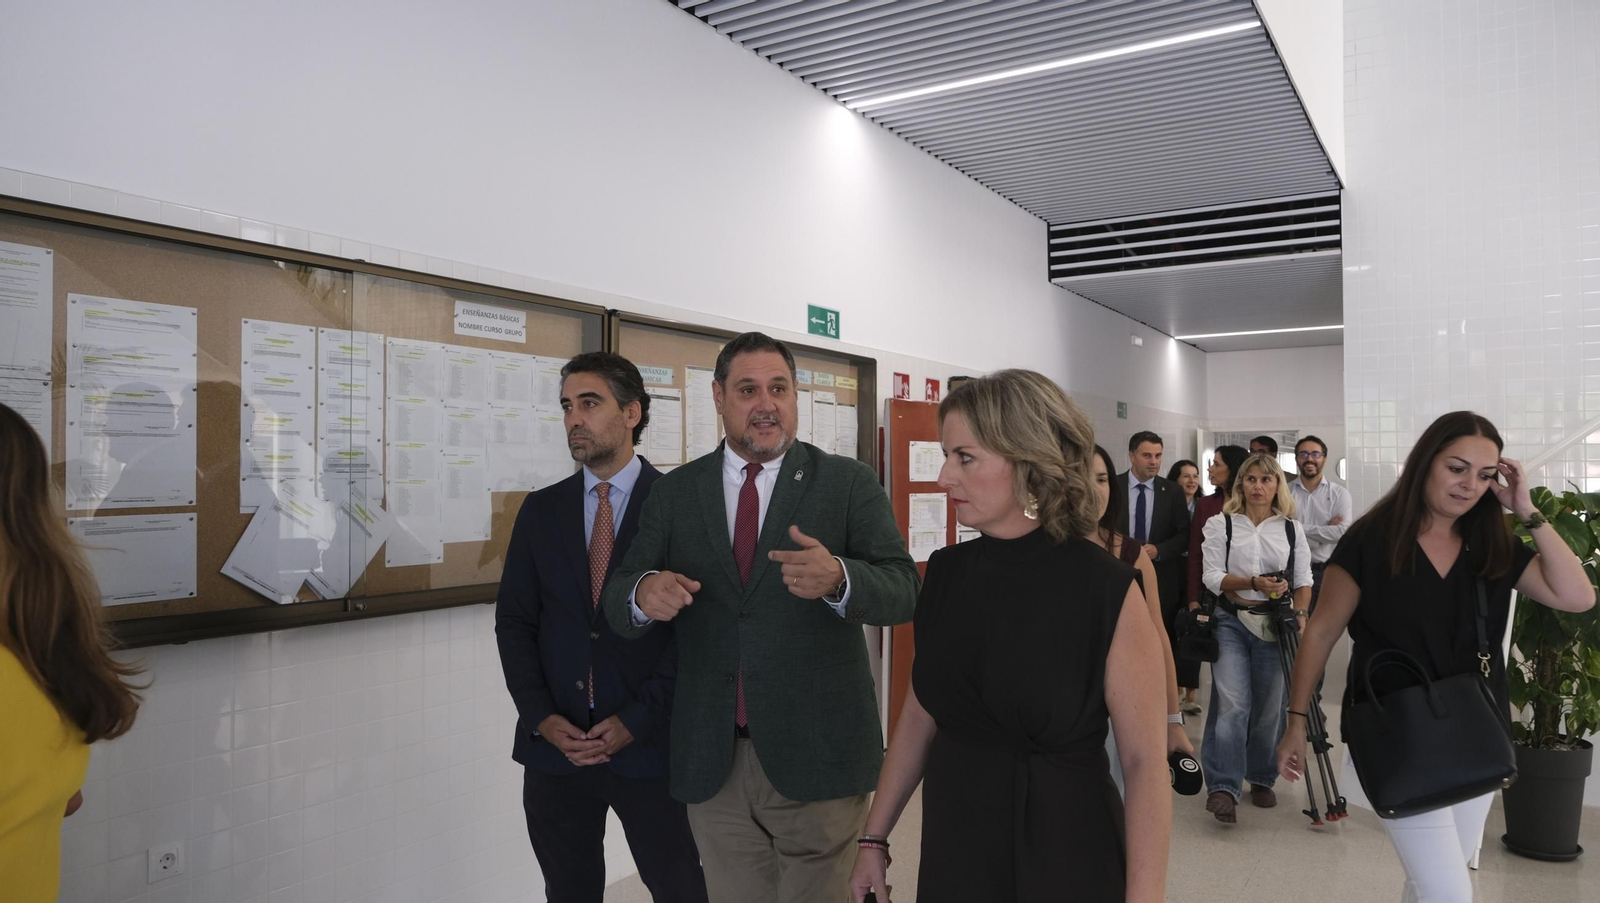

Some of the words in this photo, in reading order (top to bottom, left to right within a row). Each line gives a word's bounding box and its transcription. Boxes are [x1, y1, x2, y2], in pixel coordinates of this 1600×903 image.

[462, 309, 498, 320] ENSEÑANZAS
[499, 313, 520, 323] BÁSICAS
[458, 322, 483, 331] NOMBRE
[484, 325, 502, 334] CURSO
